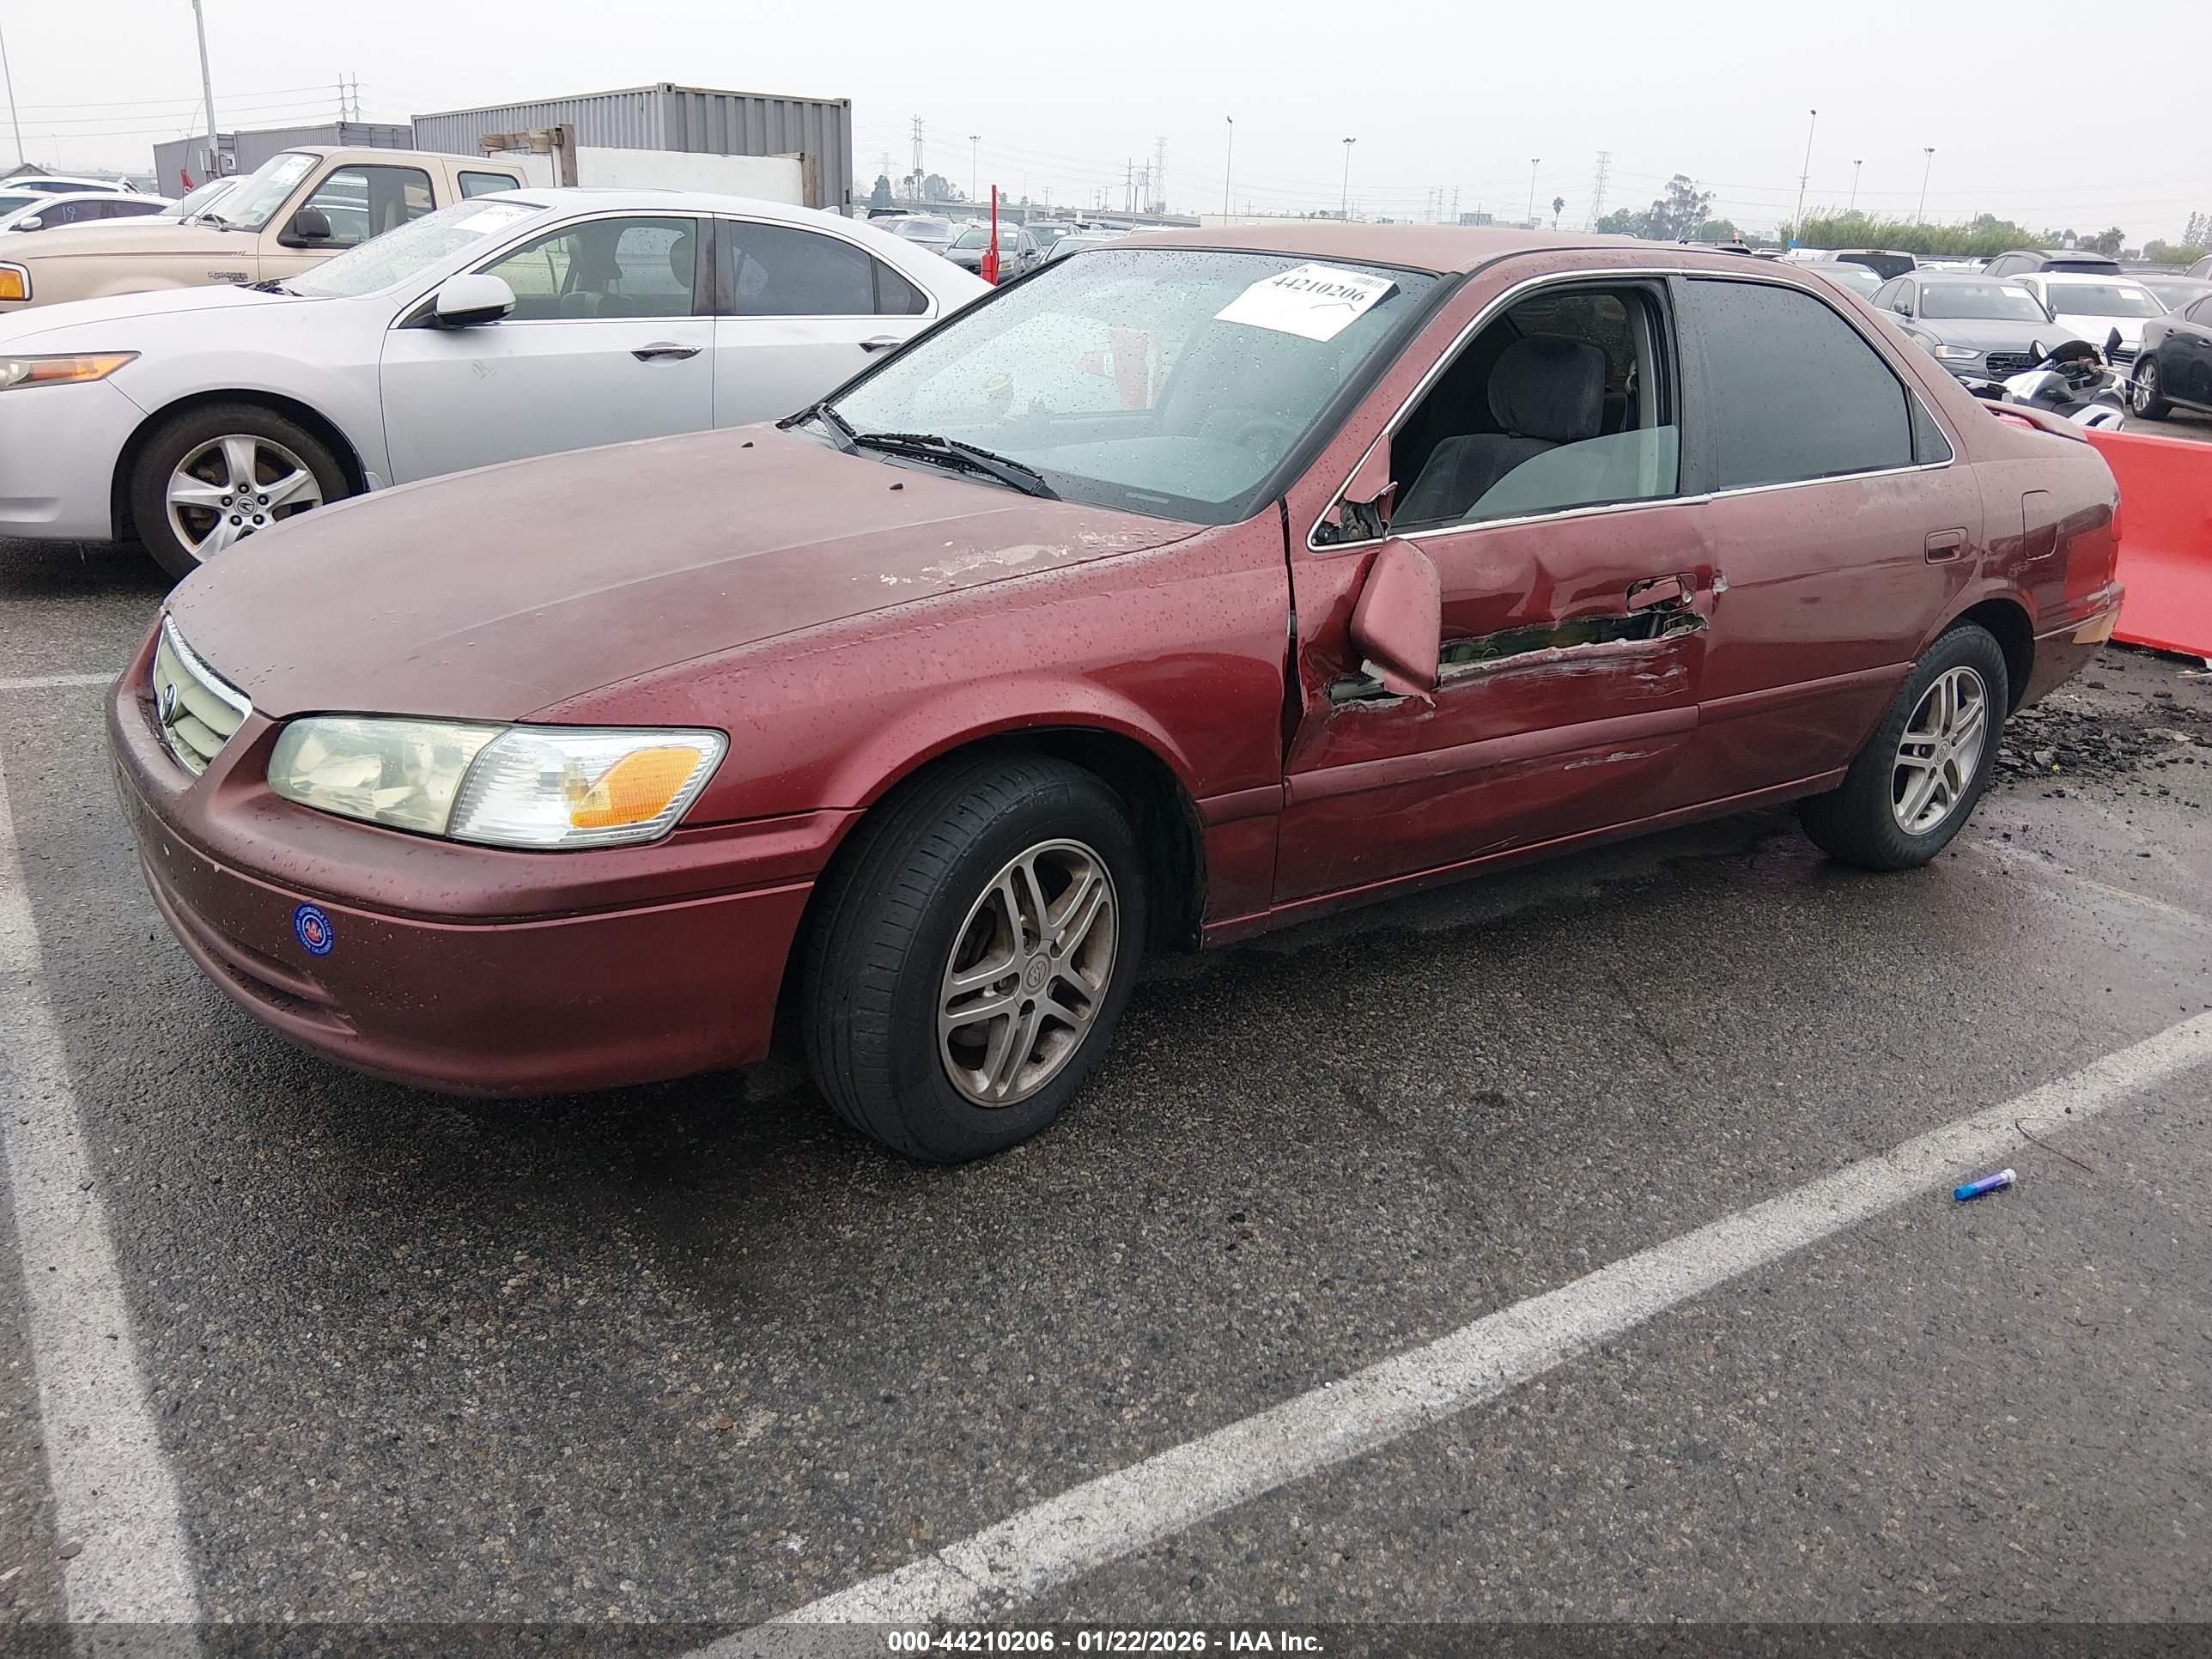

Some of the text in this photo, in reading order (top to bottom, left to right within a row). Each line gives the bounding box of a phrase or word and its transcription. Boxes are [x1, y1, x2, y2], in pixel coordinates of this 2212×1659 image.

[845, 188, 851, 204] 1
[1273, 276, 1367, 301] 44210206
[305, 921, 323, 939] AAA
